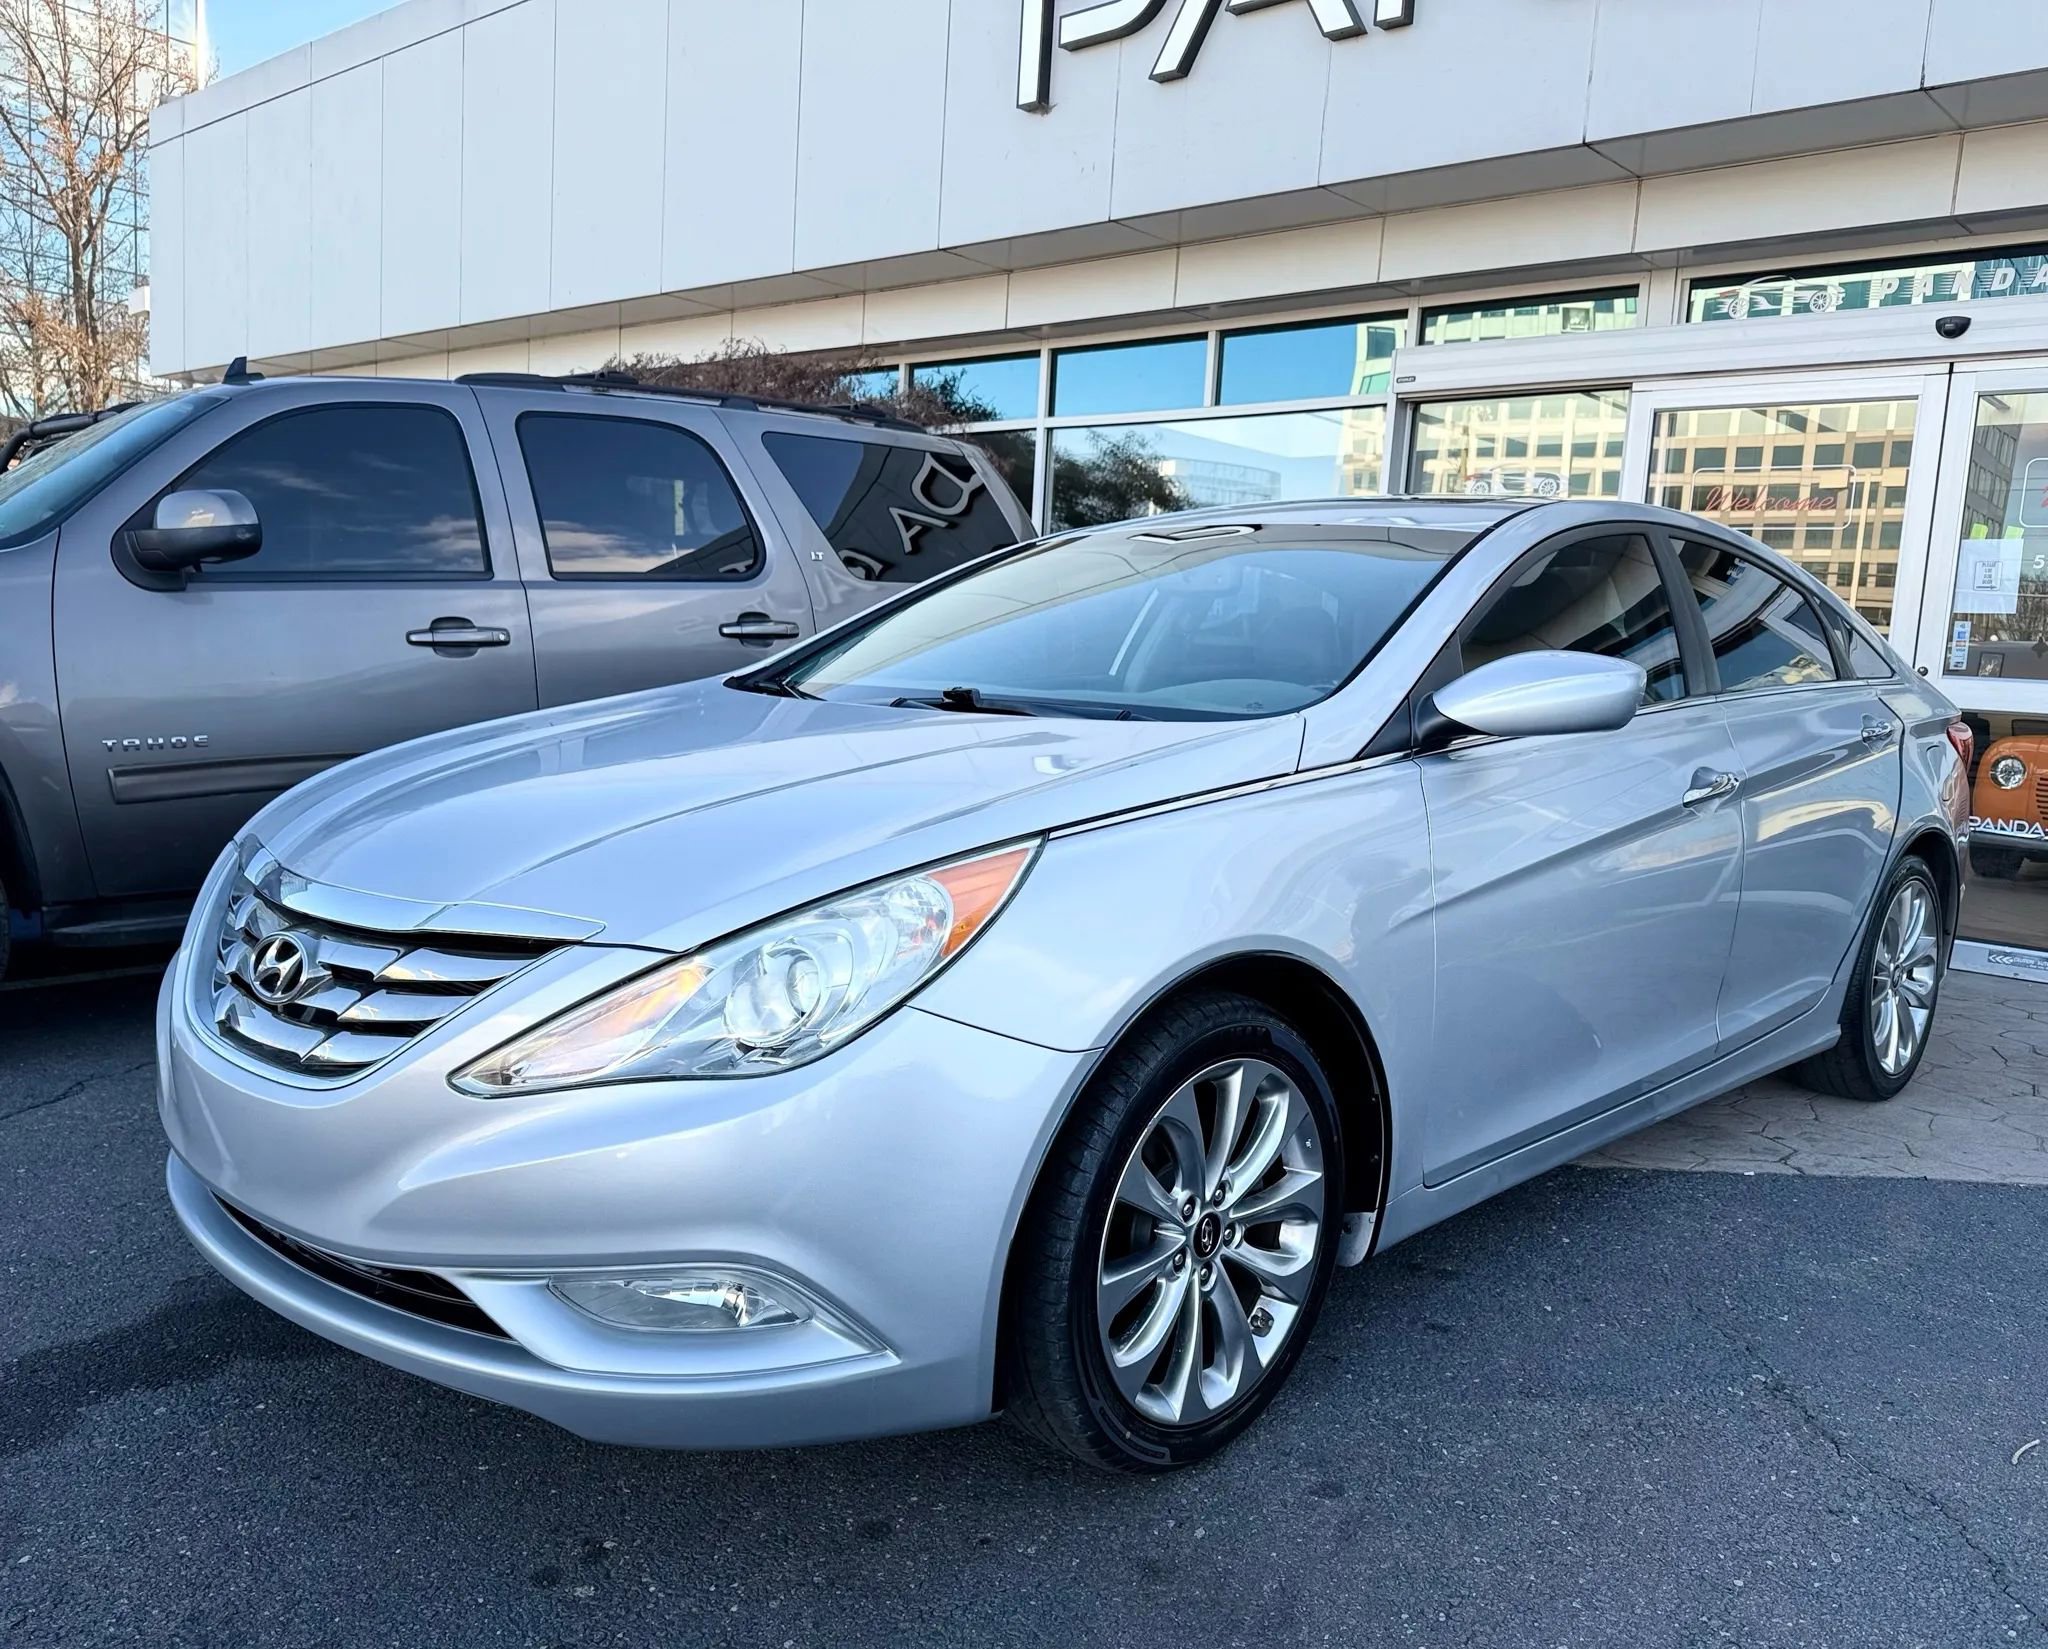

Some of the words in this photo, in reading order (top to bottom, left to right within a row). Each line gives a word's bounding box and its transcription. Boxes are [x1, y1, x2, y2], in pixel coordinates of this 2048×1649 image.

[1878, 262, 2048, 301] PANDA
[1704, 484, 1837, 513] Welcome
[810, 551, 825, 561] LT
[102, 735, 209, 752] TAHOE
[1968, 815, 2046, 837] PANDA
